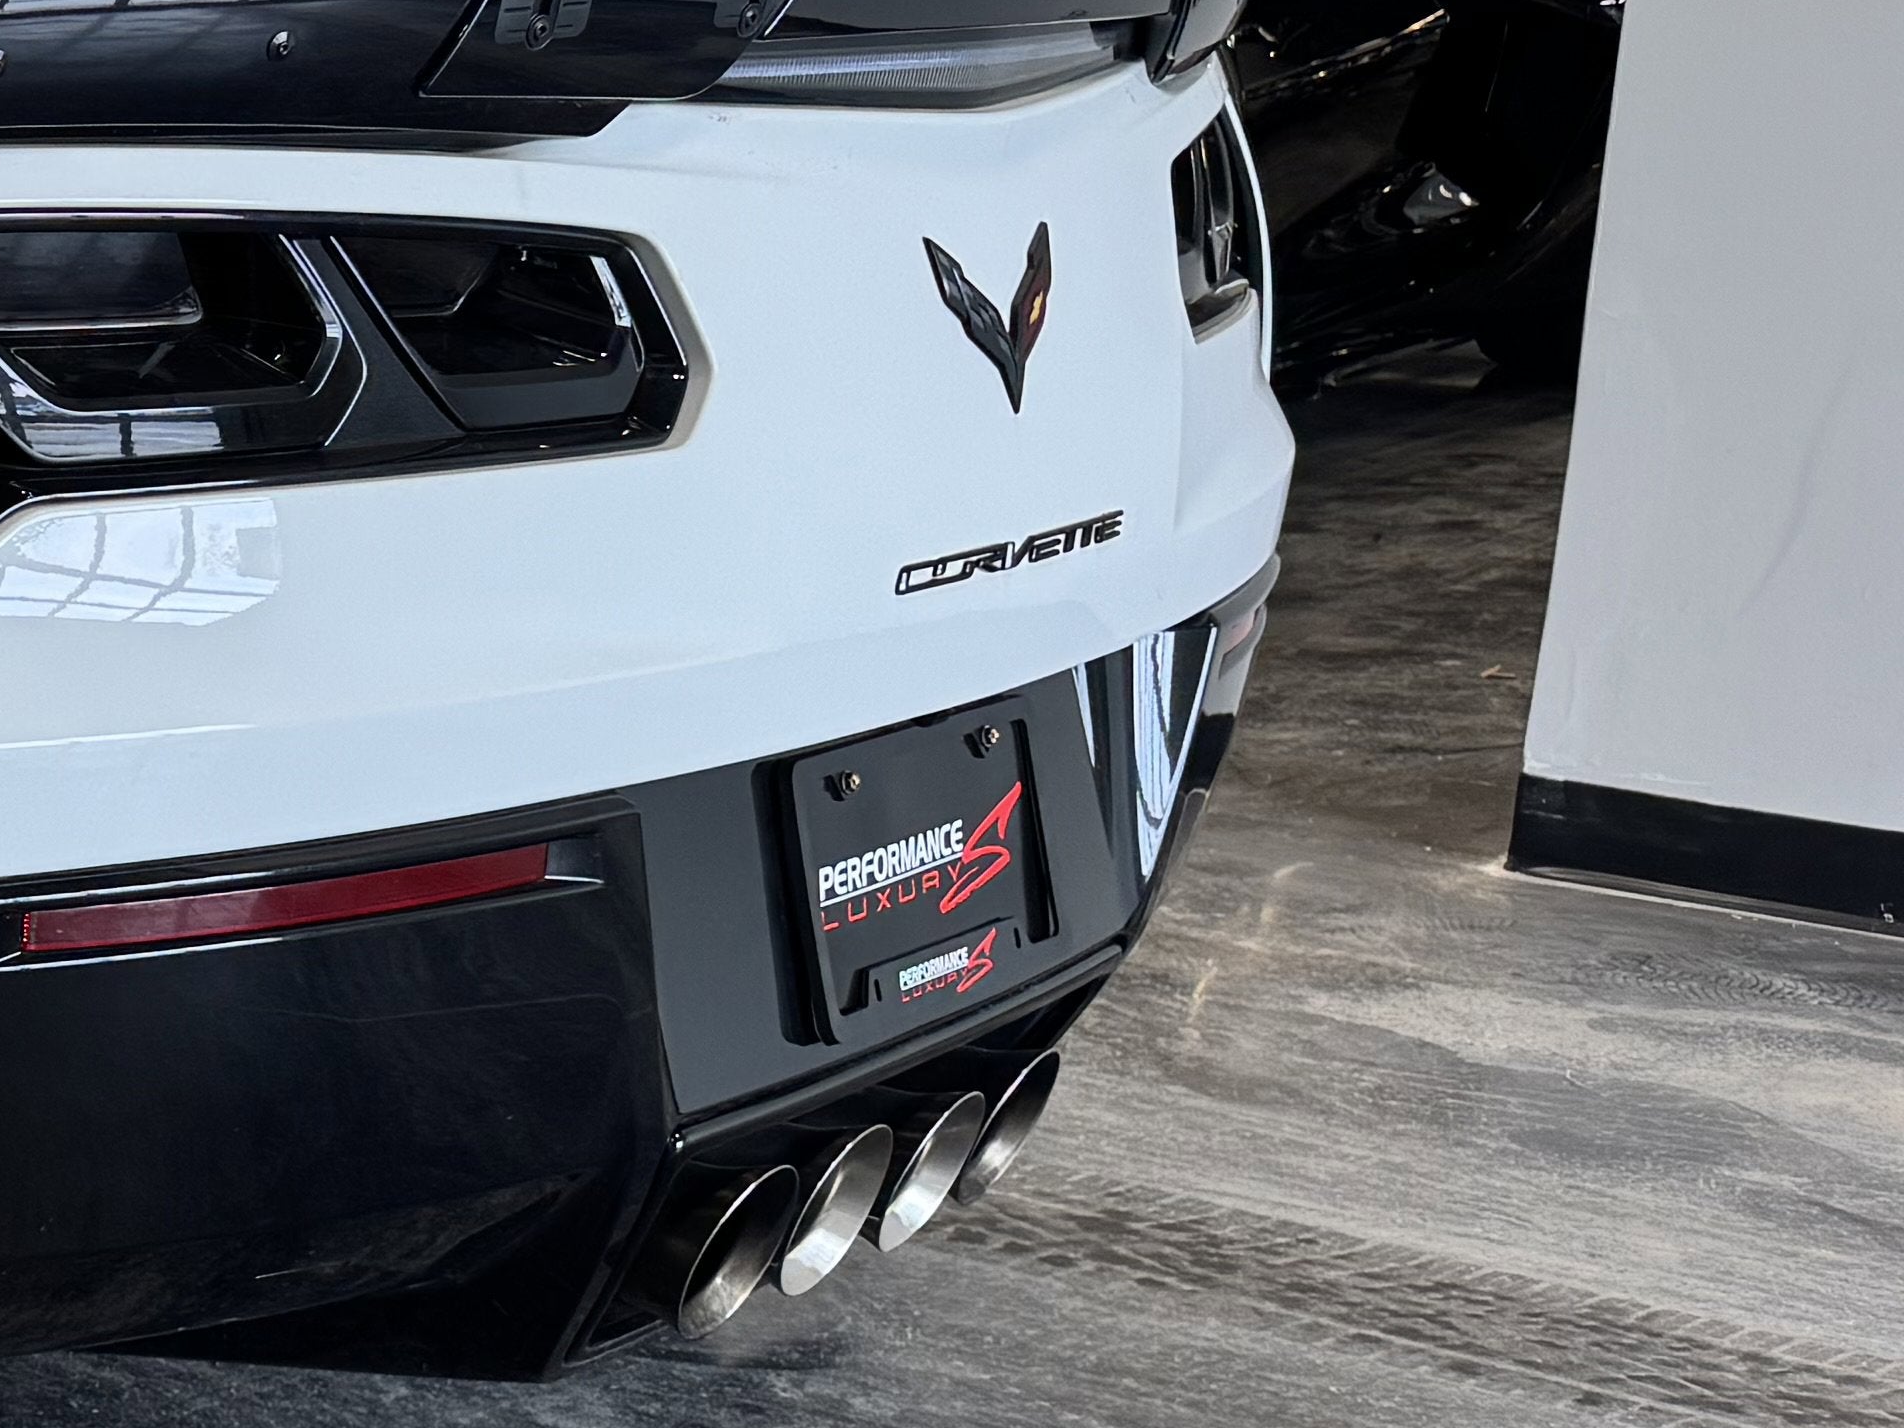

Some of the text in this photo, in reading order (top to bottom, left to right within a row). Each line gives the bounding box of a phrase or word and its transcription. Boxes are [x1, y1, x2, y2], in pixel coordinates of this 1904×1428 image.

[895, 509, 1124, 595] CORVETTE
[819, 818, 964, 904] PERFORMANCE
[820, 864, 962, 932] LUXURY
[899, 946, 970, 991] PERFORMANCE
[902, 968, 970, 1003] LUXURY
